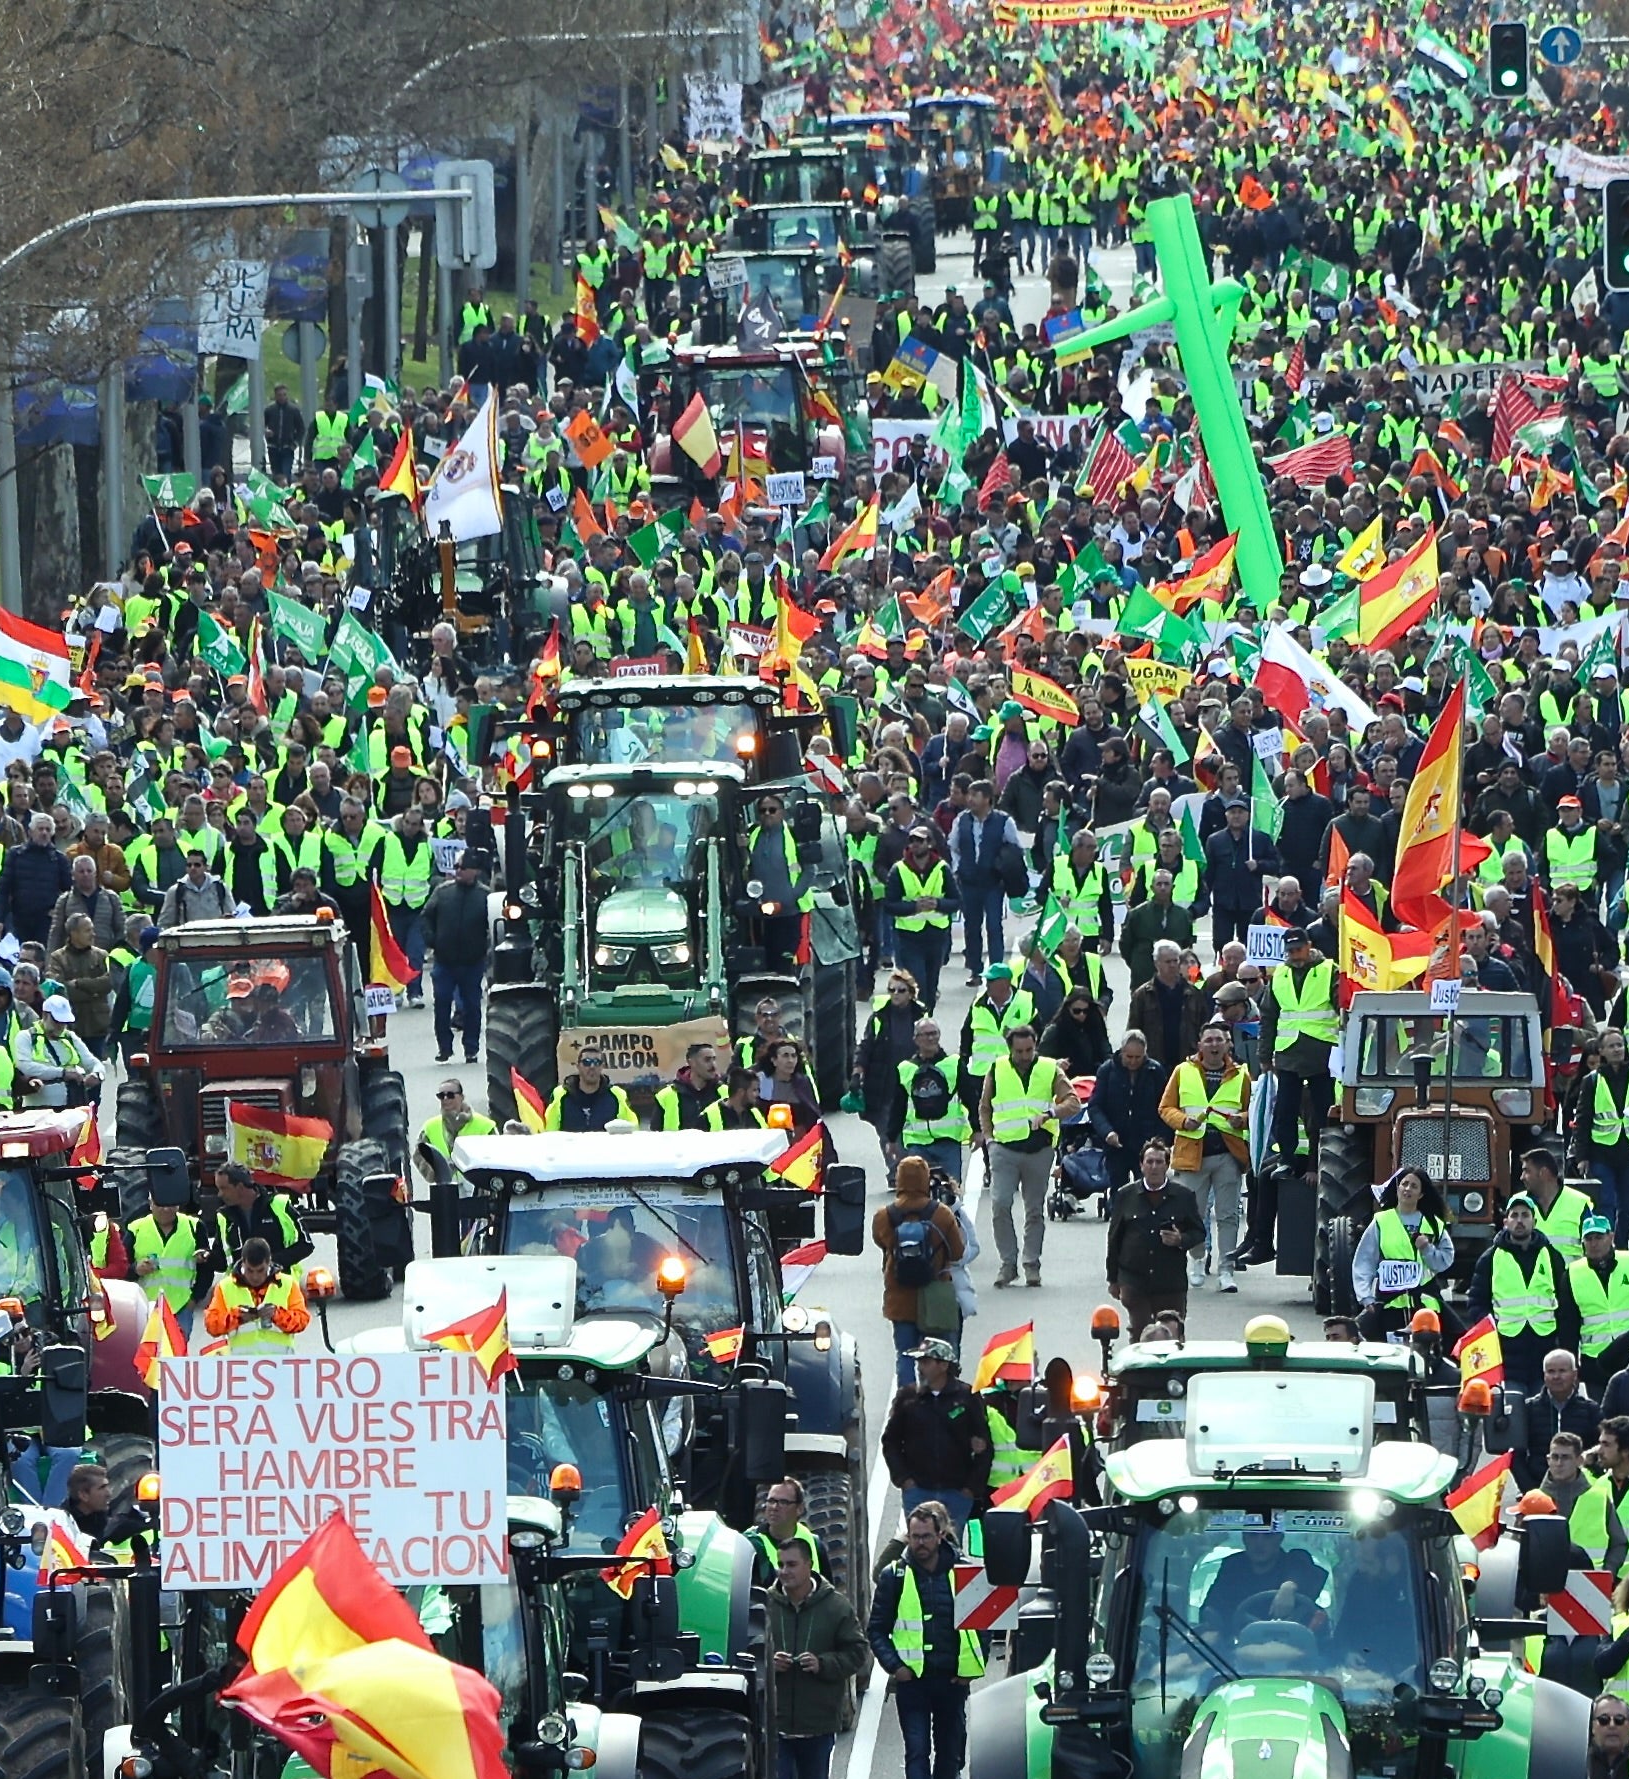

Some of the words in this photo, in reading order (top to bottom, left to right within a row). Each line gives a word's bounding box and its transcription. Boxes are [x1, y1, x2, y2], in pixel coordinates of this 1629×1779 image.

[226, 314, 257, 342] RA
[1130, 666, 1178, 680] UGAM
[158, 1356, 382, 1403] NUESTRO
[159, 1403, 279, 1448] SERA
[294, 1398, 507, 1445] VUESTRA
[218, 1446, 418, 1492] HAMBRE
[162, 1492, 373, 1539] DEFIENDE
[423, 1489, 493, 1532] TU
